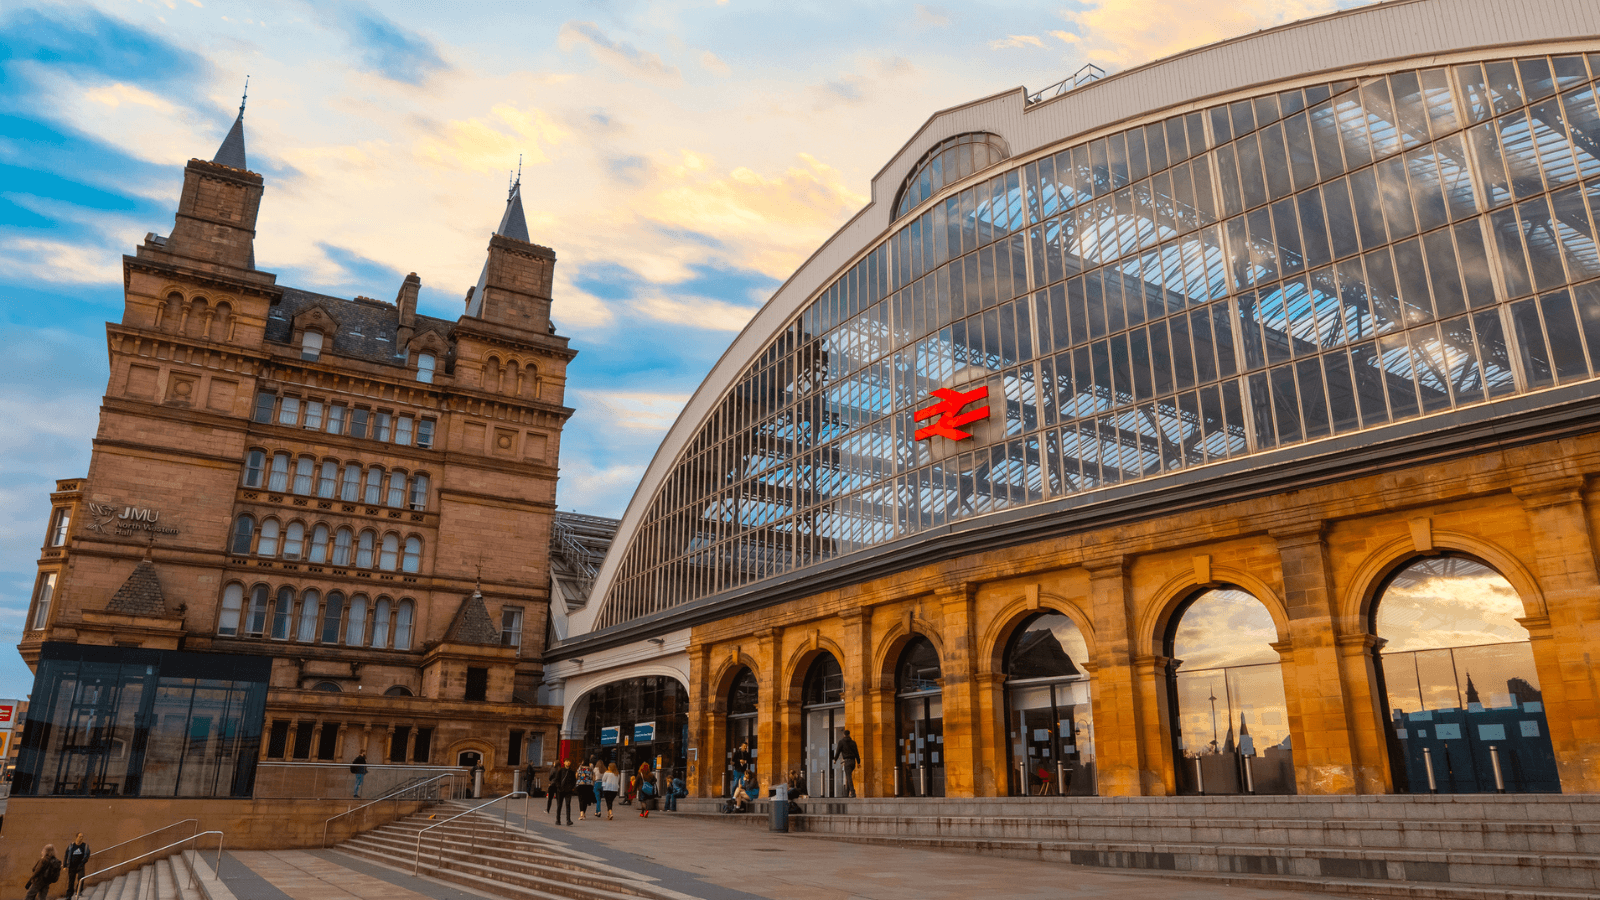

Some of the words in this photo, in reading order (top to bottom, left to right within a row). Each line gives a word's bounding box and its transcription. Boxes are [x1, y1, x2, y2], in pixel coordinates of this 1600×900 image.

[118, 506, 159, 523] JMU
[116, 521, 141, 530] North
[115, 528, 133, 536] Hall
